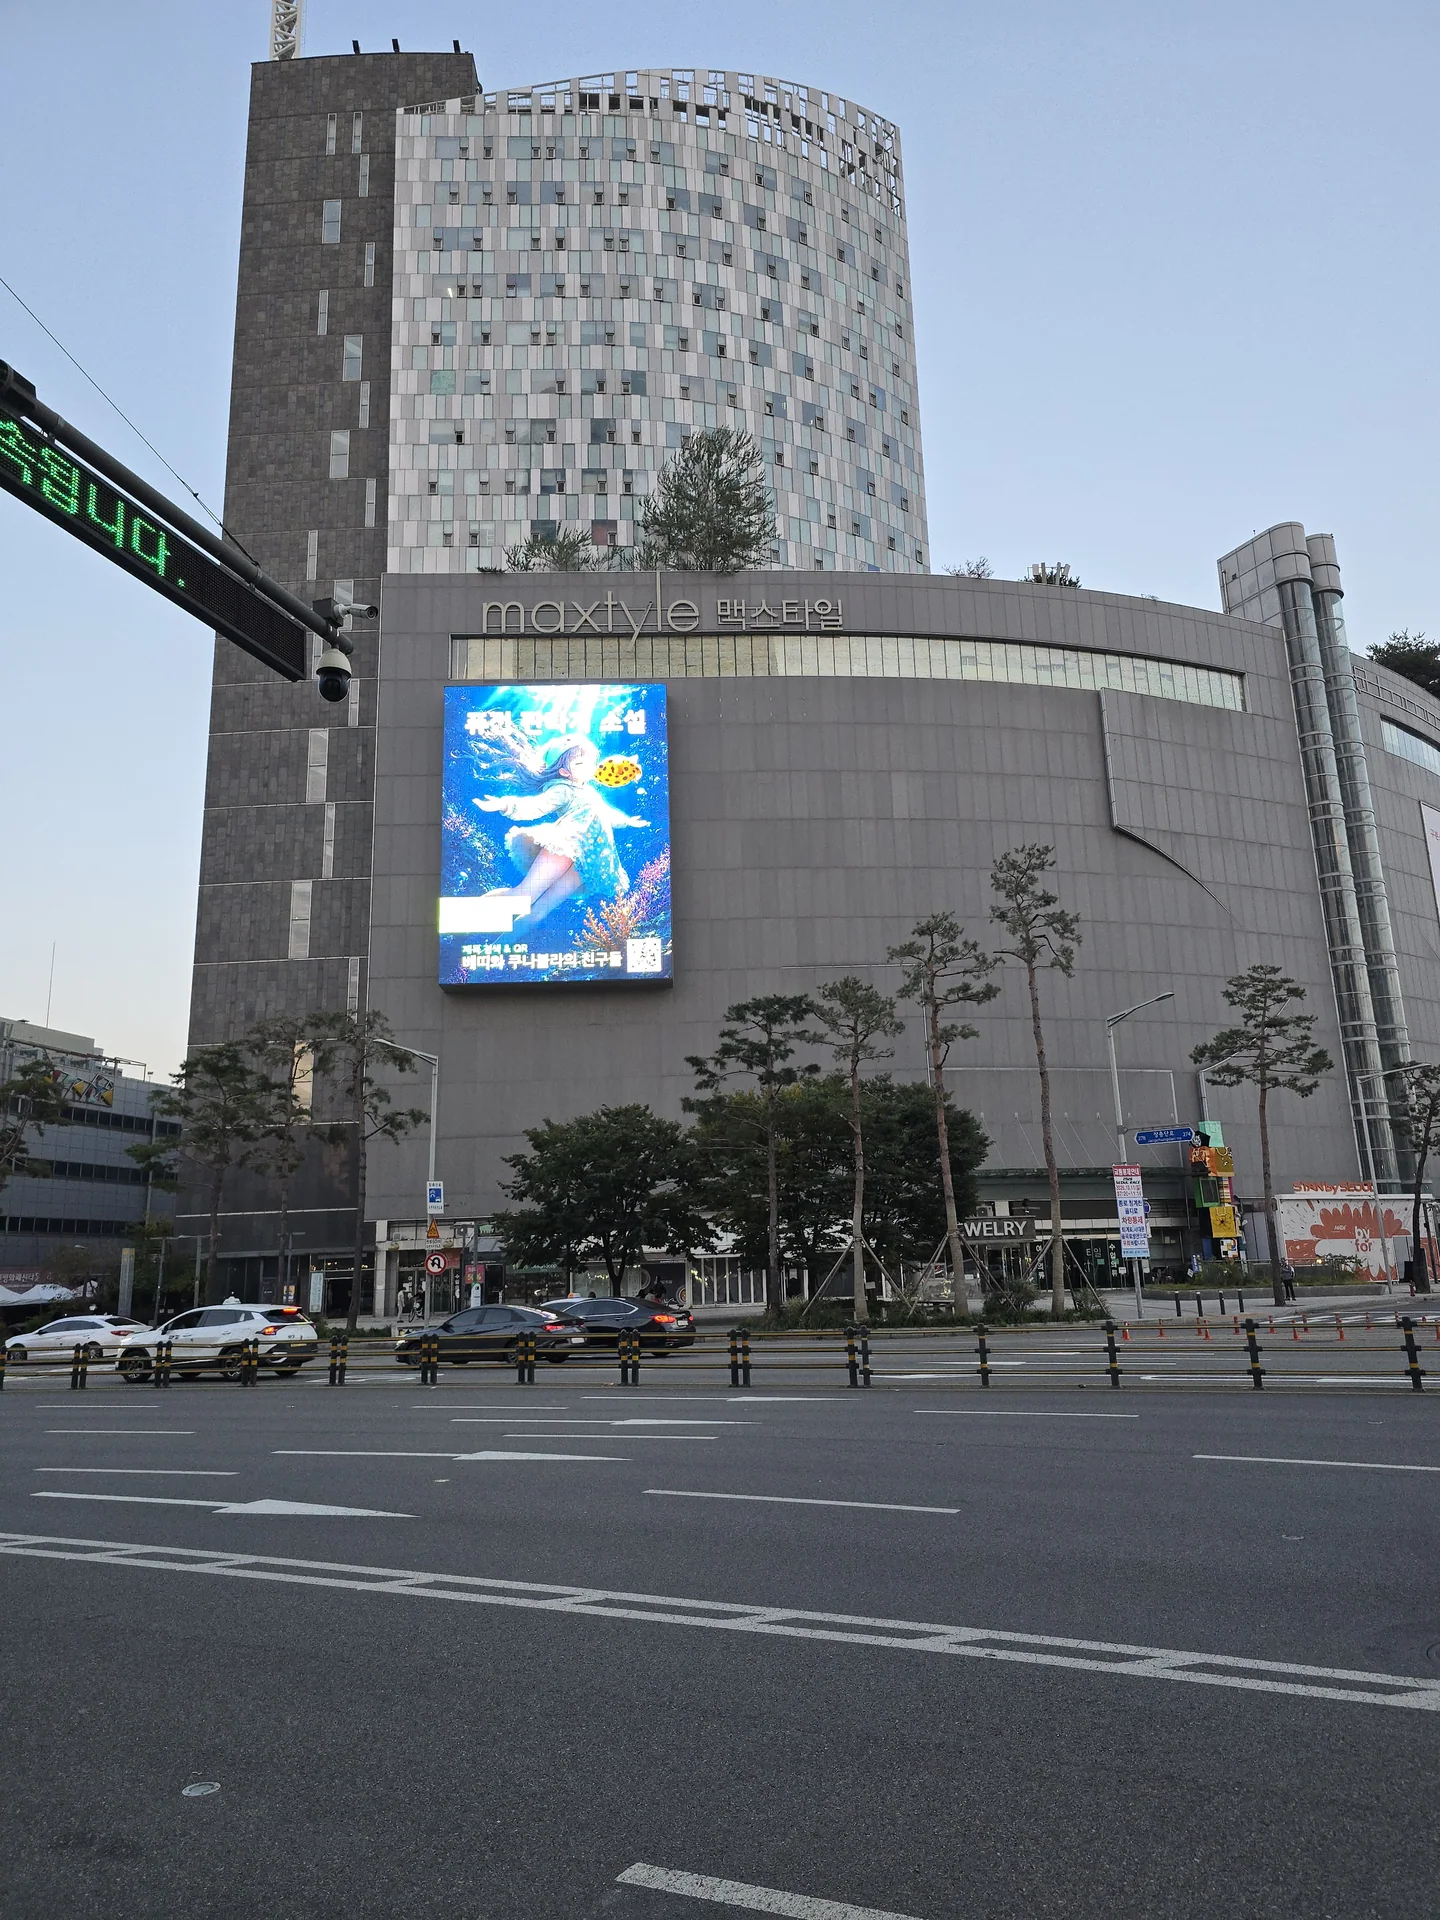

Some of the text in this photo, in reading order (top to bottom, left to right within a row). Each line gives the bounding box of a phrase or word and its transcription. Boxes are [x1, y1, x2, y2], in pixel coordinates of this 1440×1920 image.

[482, 571, 844, 646] maxtyle 맥스타일
[600, 708, 647, 735] 소설
[513, 943, 529, 953] QR
[581, 950, 623, 967] 친구들
[1153, 1130, 1175, 1138] 장충단로
[1122, 1216, 1143, 1225] 차량통제
[1355, 1225, 1370, 1243] by
[1355, 1239, 1373, 1252] for
[1036, 1245, 1046, 1280] 여의류
